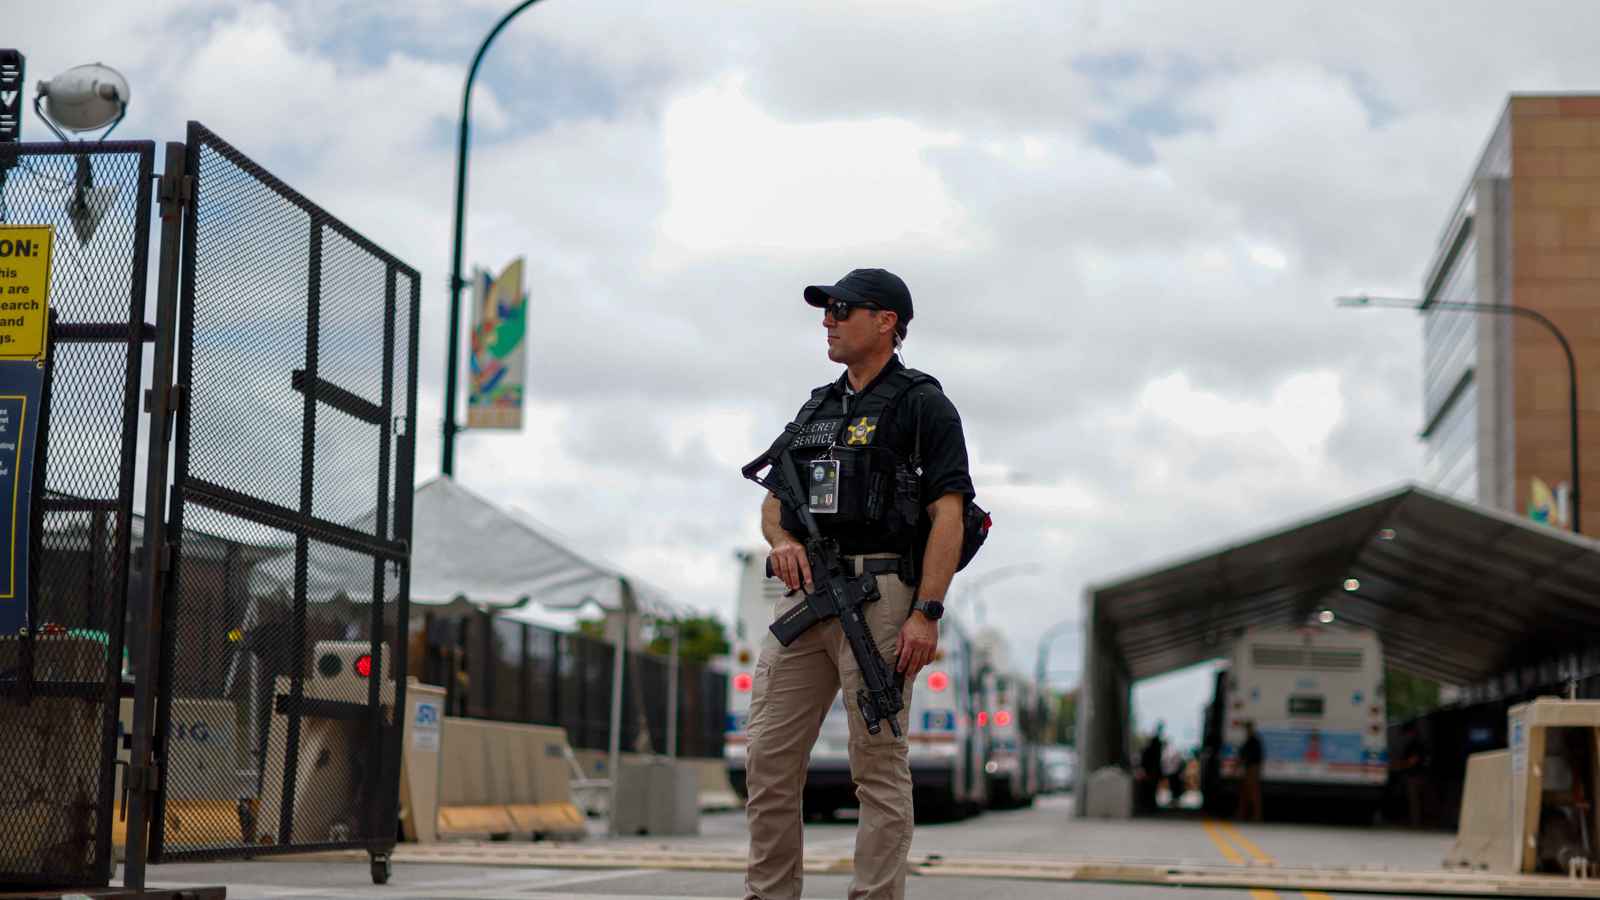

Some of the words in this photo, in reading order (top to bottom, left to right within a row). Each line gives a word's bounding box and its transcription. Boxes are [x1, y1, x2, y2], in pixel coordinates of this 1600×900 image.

[0, 239, 39, 257] ON:
[8, 286, 30, 294] are
[0, 316, 24, 326] and
[800, 422, 836, 434] SECRET
[794, 432, 834, 447] SERVICE
